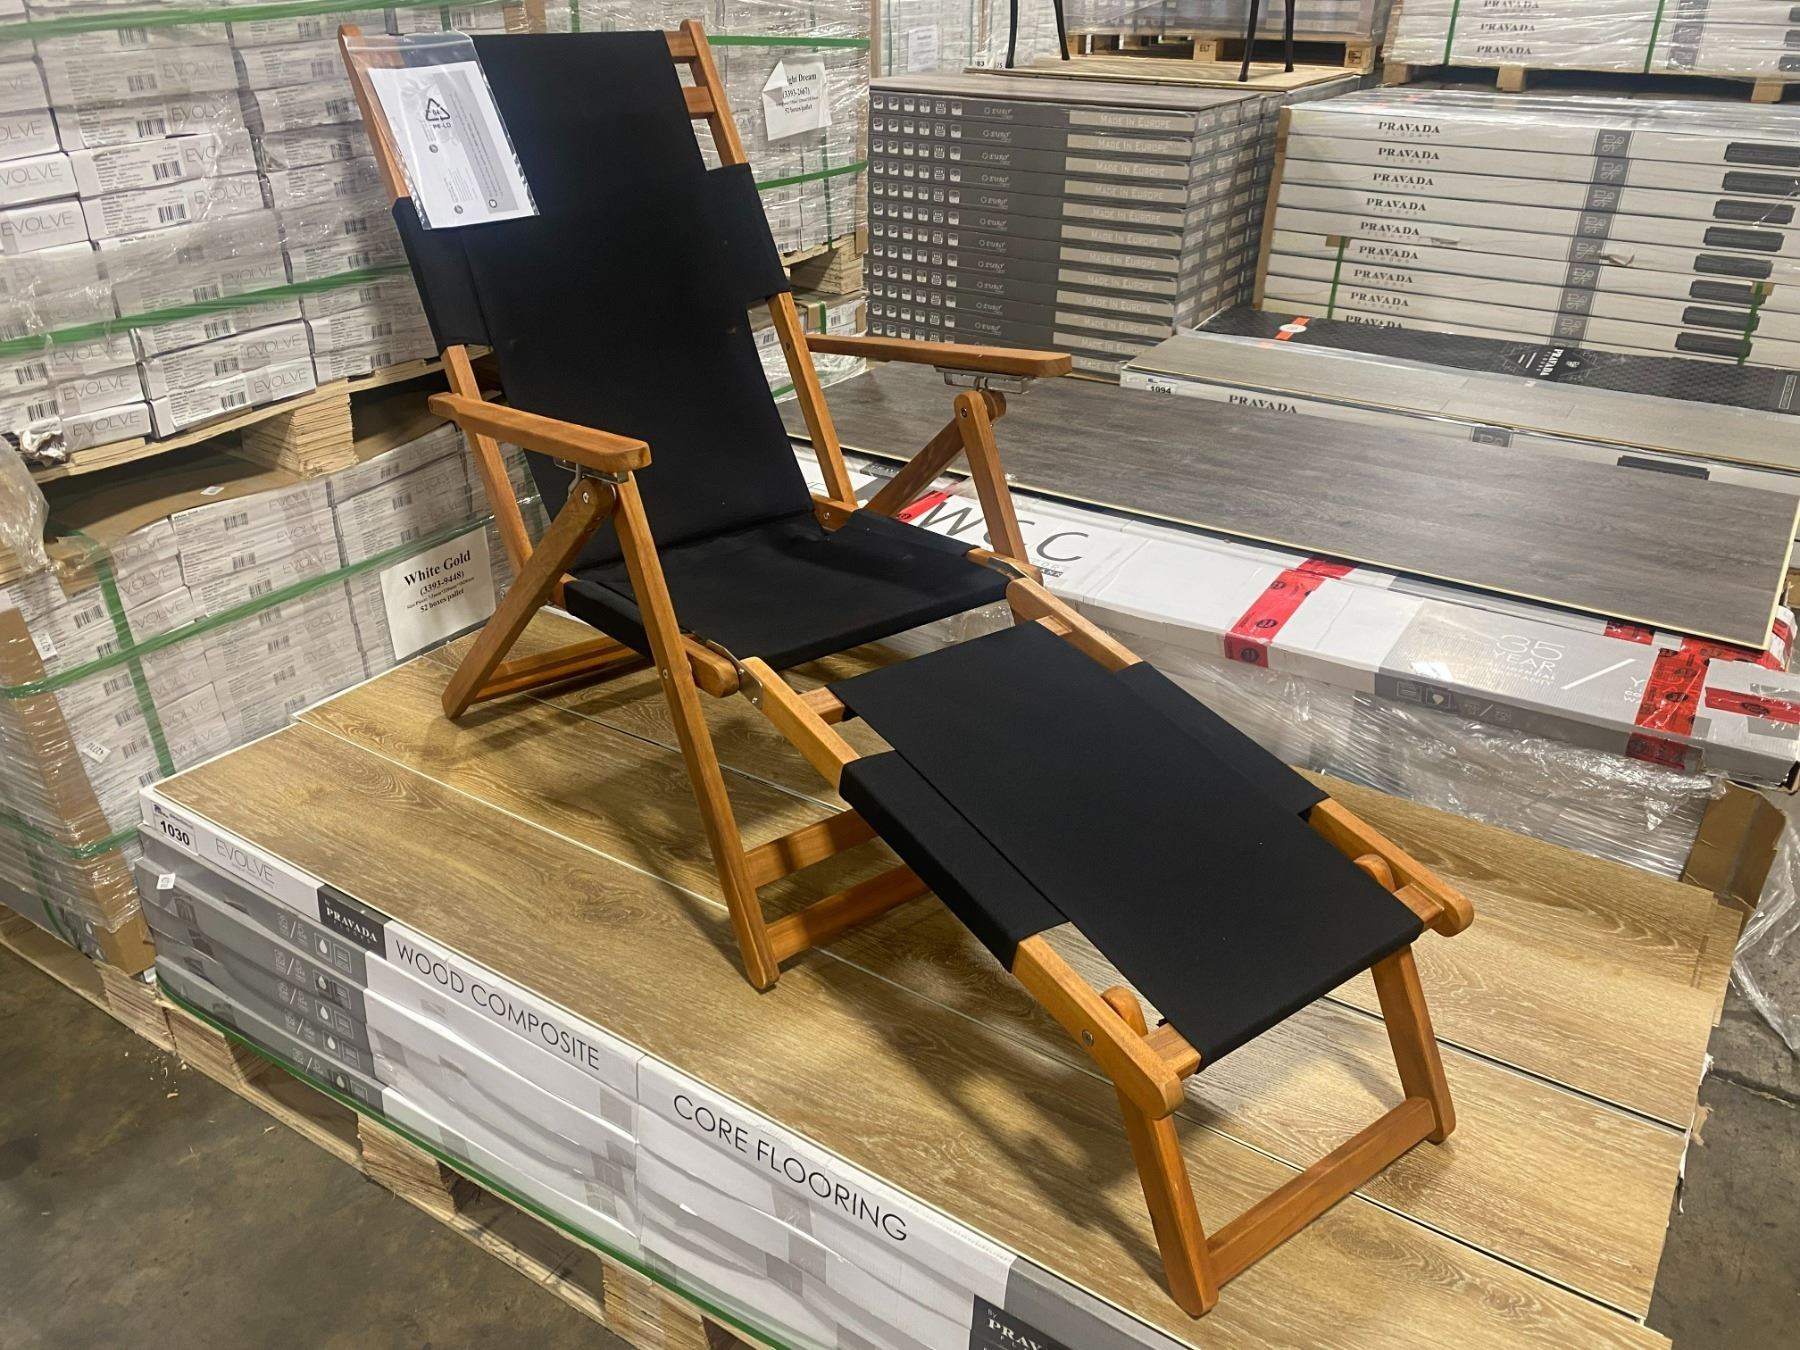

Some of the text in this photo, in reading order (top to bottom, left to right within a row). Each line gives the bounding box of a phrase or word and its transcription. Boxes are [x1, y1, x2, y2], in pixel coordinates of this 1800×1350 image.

[1480, 23, 1535, 32] PRAVADA
[1477, 45, 1532, 55] PRAVADA
[1378, 121, 1441, 134] PRAVADA
[1378, 147, 1440, 161] PRAVADA
[1373, 172, 1434, 186] PRAVADA
[1366, 197, 1427, 212] PRAVADA
[1, 210, 74, 237] EVOLVE
[1360, 221, 1420, 236] PRAVADA
[1359, 245, 1419, 260] PRAVADA
[1354, 269, 1413, 284] PRAVADA
[1350, 291, 1409, 307] PRAVADA
[1540, 348, 1564, 376] PRAVADA
[63, 374, 129, 400] EVOLVE
[254, 369, 308, 394] EVOLVE
[1150, 386, 1171, 395] 1094
[1229, 394, 1297, 414] PRAVADA
[73, 412, 142, 437] EVOLVE
[404, 549, 472, 587] White Gold
[420, 571, 465, 597] (3393-9448)
[1497, 634, 1566, 662] 35
[1493, 651, 1557, 673] YEAR
[160, 819, 190, 847] 1030
[215, 837, 275, 885] EVOLVE
[326, 908, 378, 943] PRAVADA
[396, 939, 600, 1071] WOOD COMPOSITE
[673, 1094, 908, 1243] CORE FLOORING
